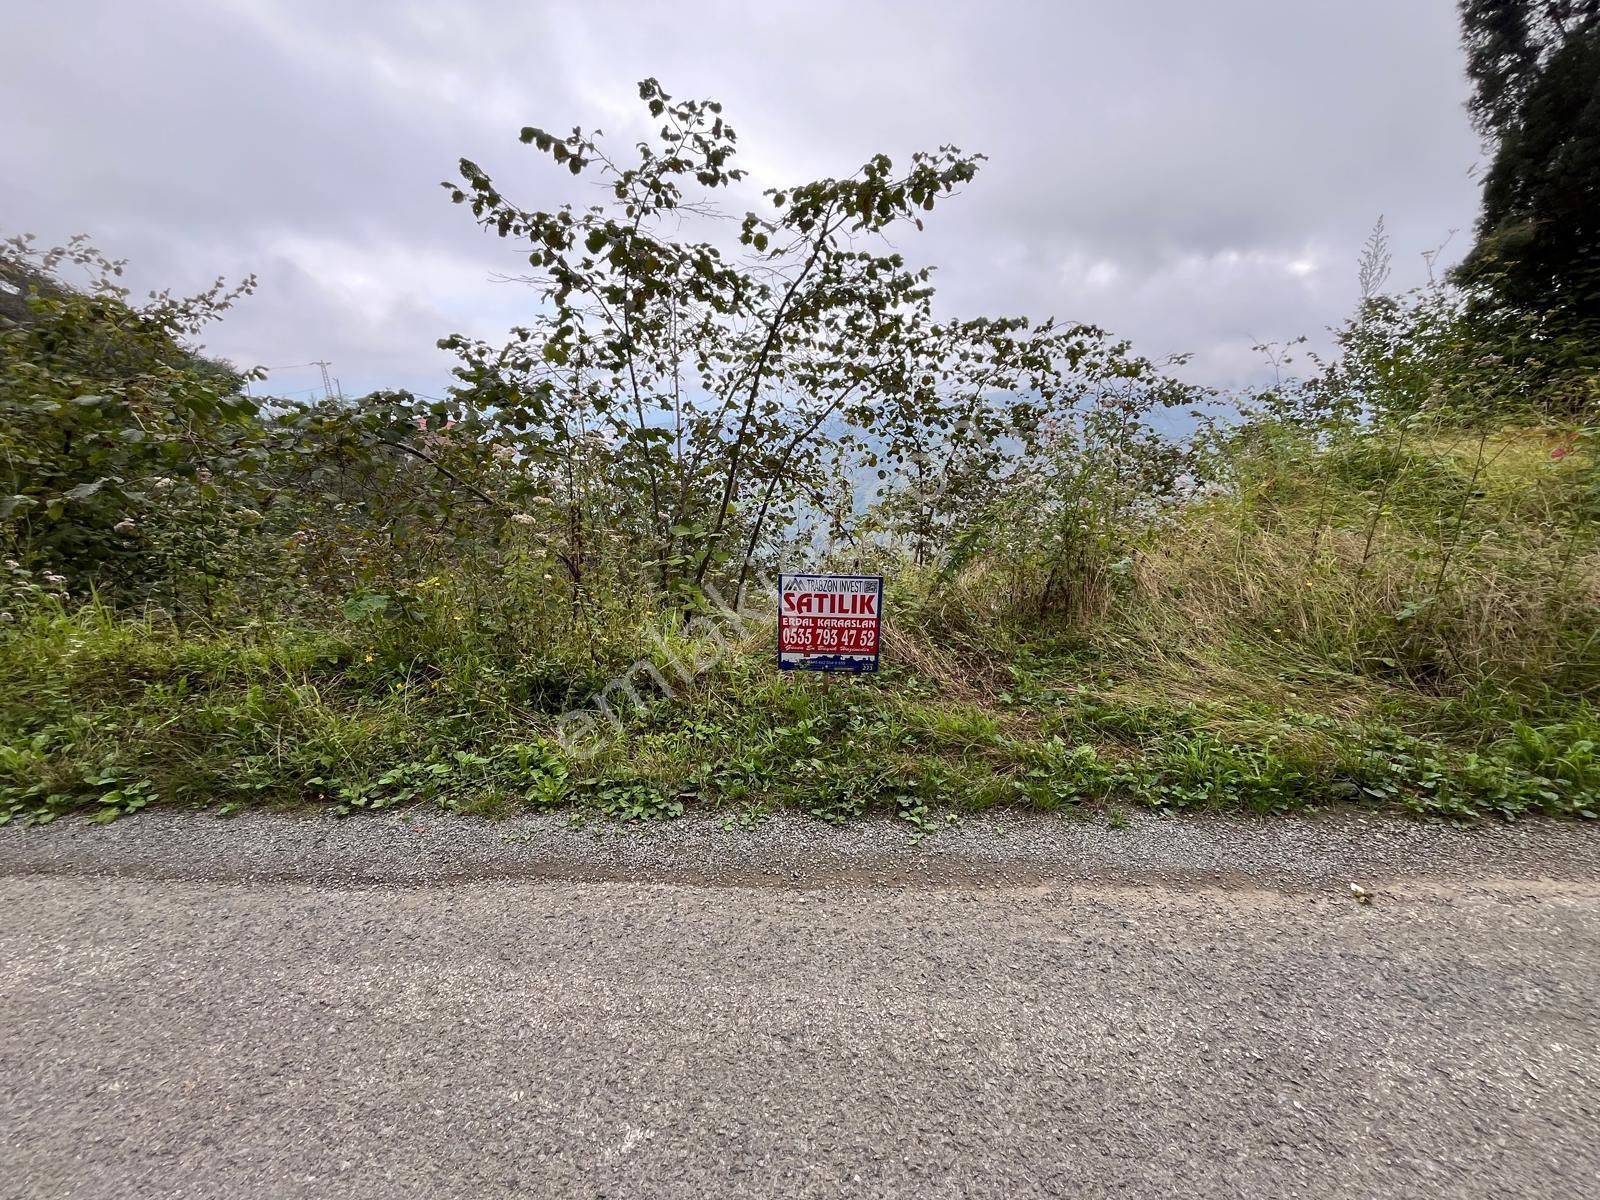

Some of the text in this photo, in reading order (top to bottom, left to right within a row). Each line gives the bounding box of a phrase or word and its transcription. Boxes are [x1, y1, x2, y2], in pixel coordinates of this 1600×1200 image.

[807, 579, 863, 593] TRABZON INVEST
[783, 592, 876, 615] SATILIK
[782, 617, 876, 629] ERDAL KARAASLAN
[783, 628, 875, 647] 0535 793 47 52
